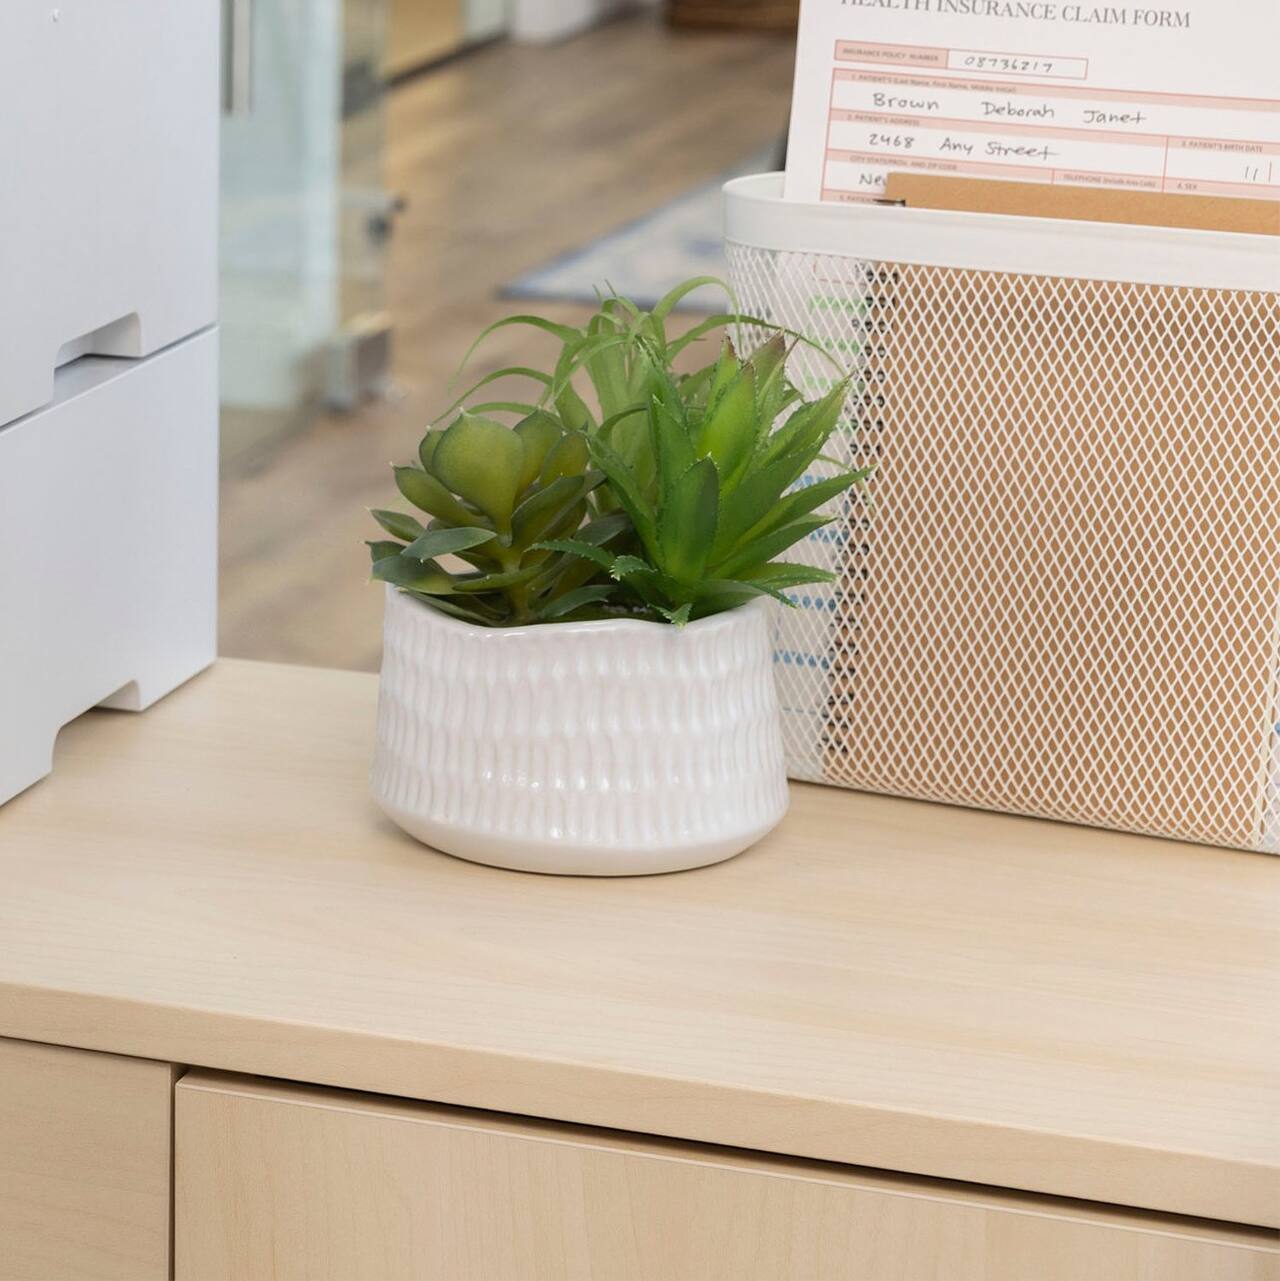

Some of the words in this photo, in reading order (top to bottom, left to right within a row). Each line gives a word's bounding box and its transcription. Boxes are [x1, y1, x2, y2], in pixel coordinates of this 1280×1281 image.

[1062, 5, 1127, 26] CLAIM
[1133, 9, 1192, 29] FORM
[842, 48, 880, 58] INSURANCE
[882, 50, 905, 59] POLICY
[909, 53, 939, 61] NUMBER
[873, 92, 940, 111] Brown
[981, 101, 1055, 118] Deborah
[1083, 109, 1147, 124] Janet
[869, 133, 915, 148] 2468
[939, 137, 973, 155] Any
[985, 141, 1061, 160] Street
[1245, 145, 1264, 153] DATE
